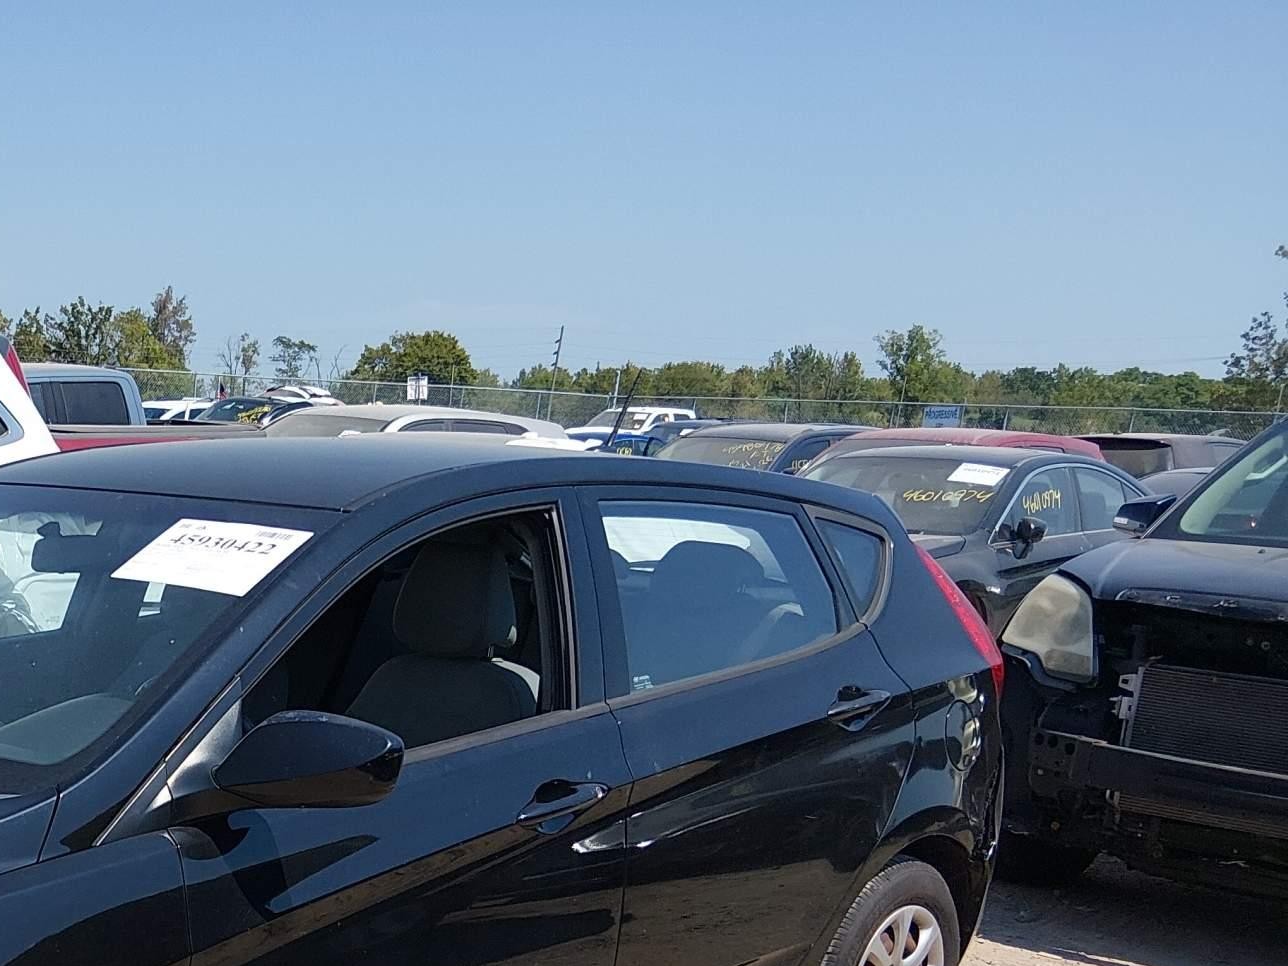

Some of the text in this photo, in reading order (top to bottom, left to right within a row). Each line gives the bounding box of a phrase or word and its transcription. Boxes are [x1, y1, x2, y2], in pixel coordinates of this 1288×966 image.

[903, 489, 995, 503] 46010974
[1022, 488, 1061, 516] 46010974
[169, 532, 278, 555] 45930422
